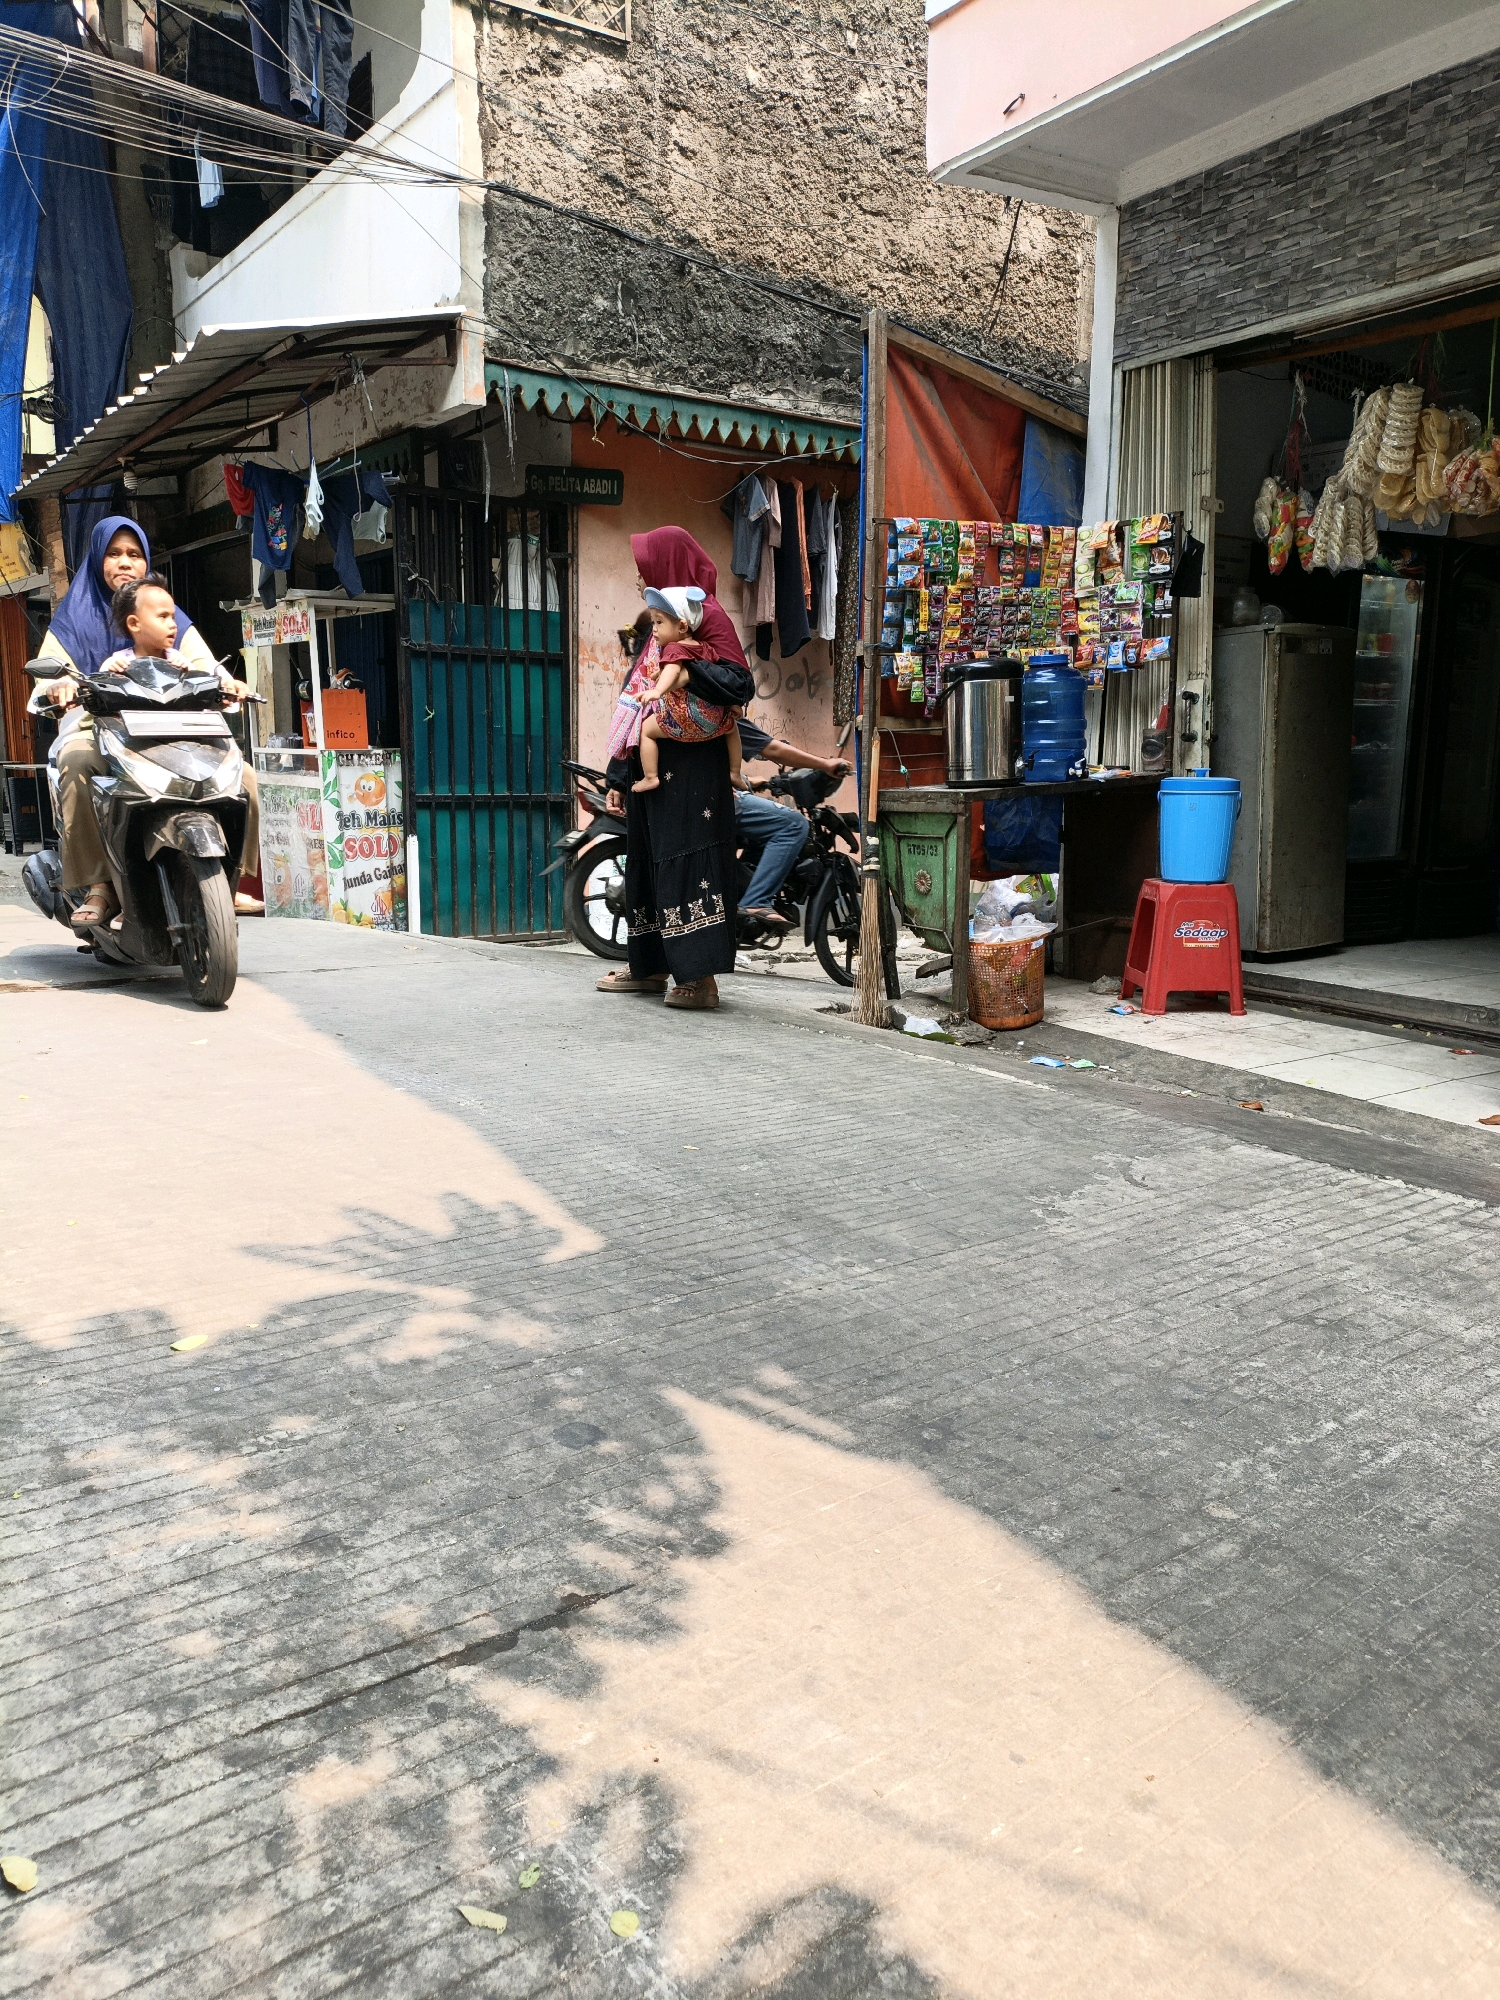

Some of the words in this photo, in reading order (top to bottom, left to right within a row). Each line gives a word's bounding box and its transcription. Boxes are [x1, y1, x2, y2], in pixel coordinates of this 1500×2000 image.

[548, 476, 581, 492] PELITA
[583, 478, 612, 495] ABADI
[282, 610, 309, 636] SOLO
[326, 729, 355, 739] infico
[344, 833, 400, 861] SOLO
[1174, 927, 1228, 938] Sedaap
